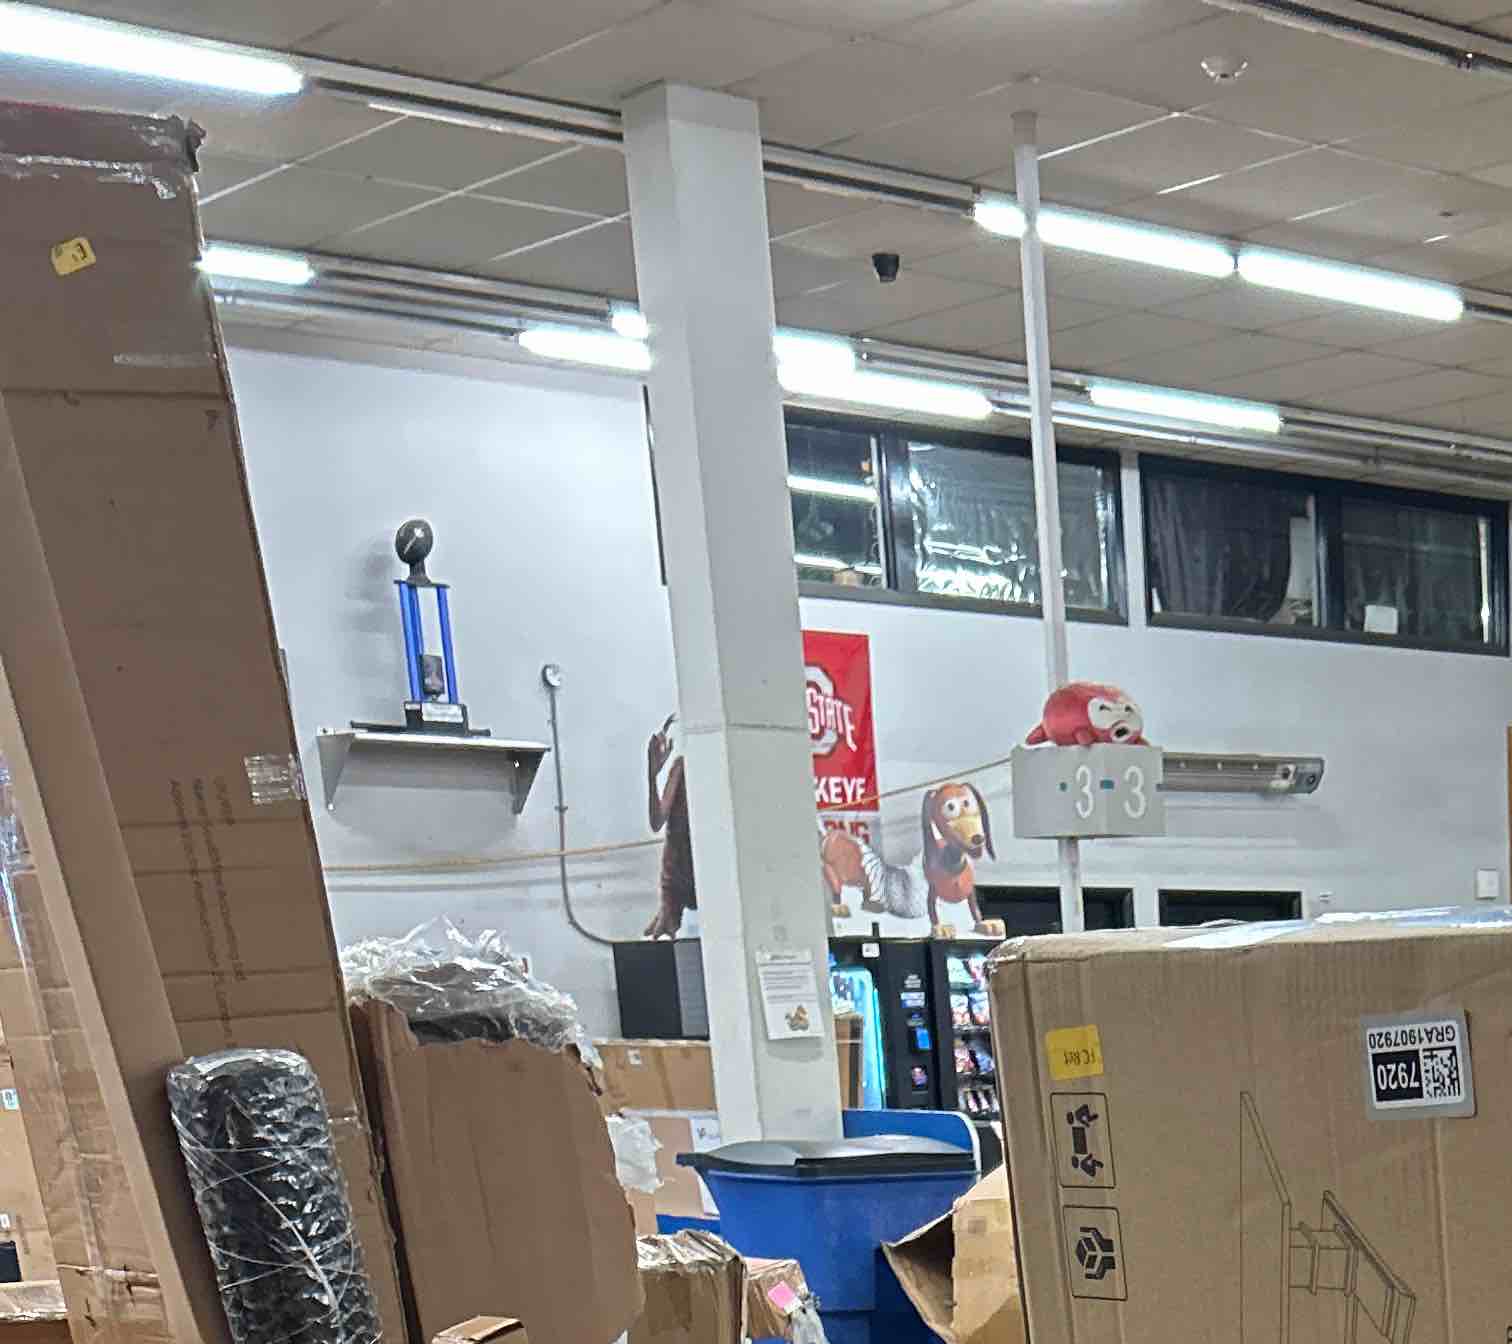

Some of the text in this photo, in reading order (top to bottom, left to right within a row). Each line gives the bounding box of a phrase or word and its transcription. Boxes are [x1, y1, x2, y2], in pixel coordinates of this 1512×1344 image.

[806, 688, 857, 752] STATE
[1076, 765, 1094, 818] 3
[1125, 766, 1146, 818] 3
[1376, 1062, 1420, 1090] 7920
